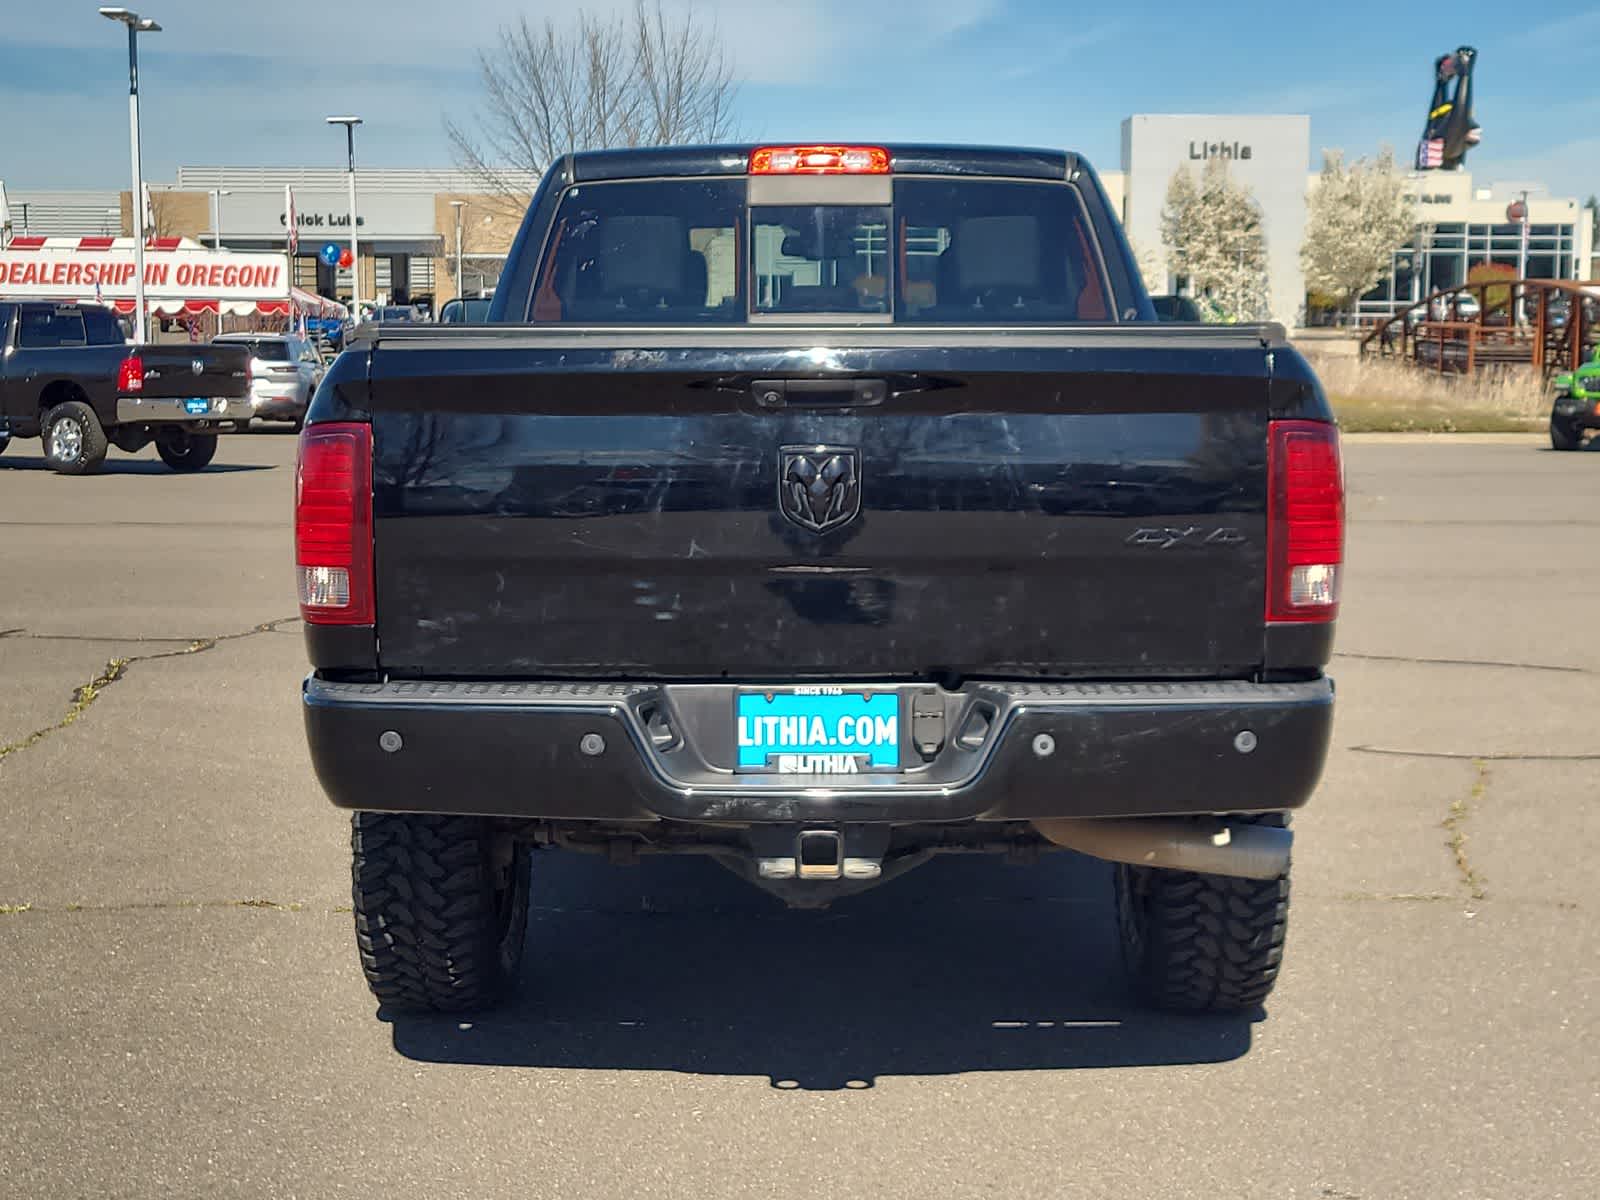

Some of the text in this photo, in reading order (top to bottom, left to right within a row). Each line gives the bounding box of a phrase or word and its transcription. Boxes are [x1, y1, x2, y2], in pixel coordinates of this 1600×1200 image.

[0, 262, 281, 287] DEALERSHIP IN OREGON!
[794, 687, 820, 696] SINCE
[737, 715, 898, 747] LITHIA.COM
[798, 755, 858, 773] LITHIA
